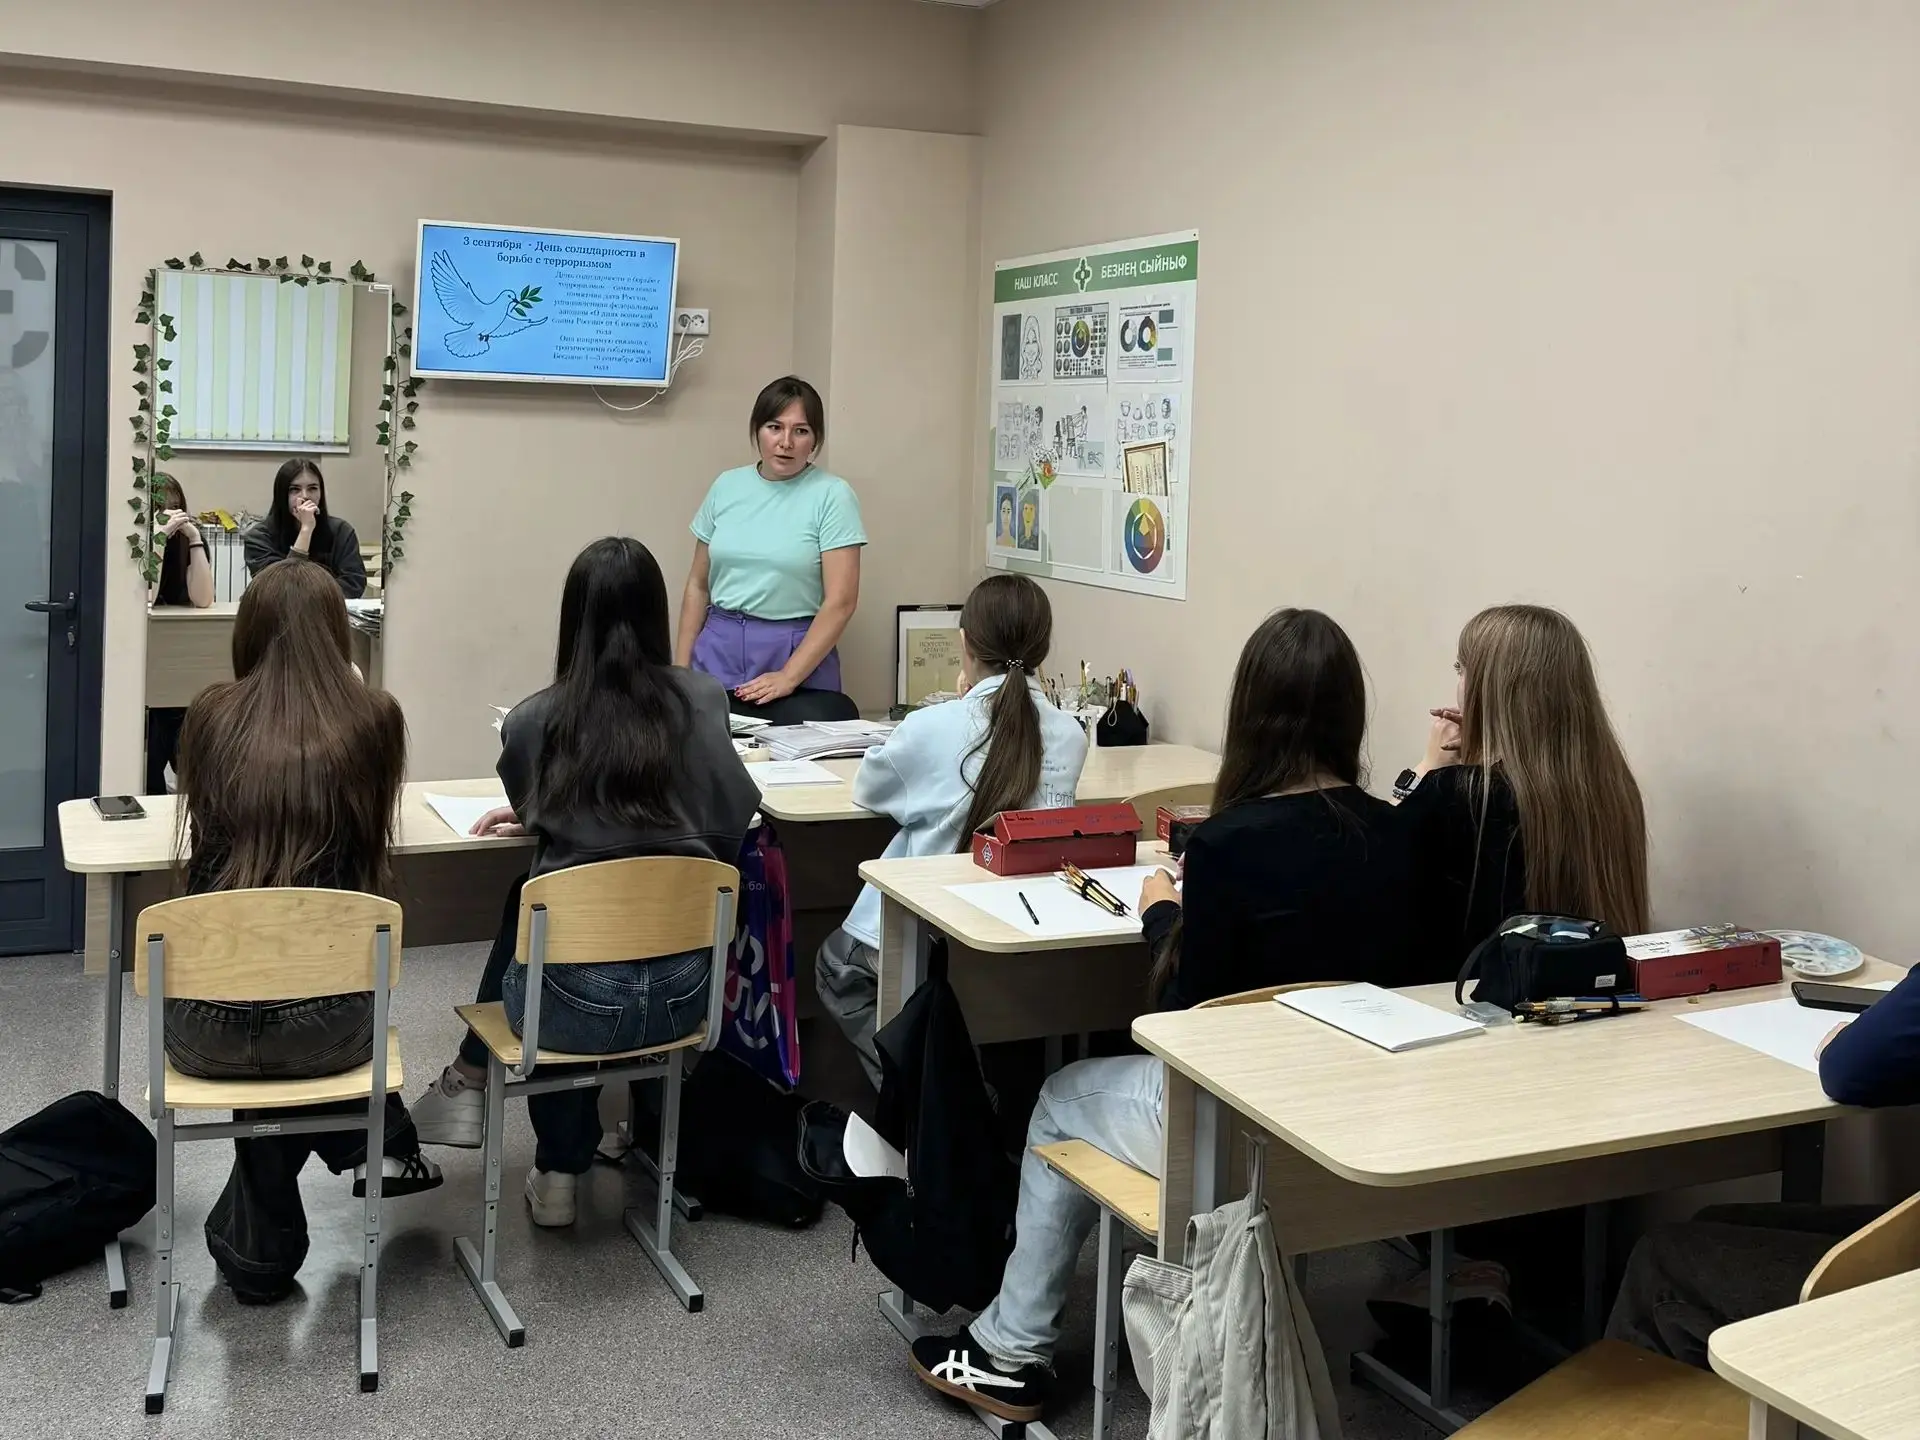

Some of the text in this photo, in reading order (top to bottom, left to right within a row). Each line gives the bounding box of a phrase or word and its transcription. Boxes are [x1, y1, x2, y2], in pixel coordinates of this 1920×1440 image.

[463, 236, 470, 246] 3
[472, 239, 522, 251] сентября
[534, 241, 563, 252] День
[565, 245, 637, 258] солидарности
[497, 252, 533, 264] борьбе
[543, 257, 612, 269] терроризмом
[1014, 277, 1032, 291] НАШ
[1033, 272, 1059, 288] КЛАСС
[1139, 254, 1188, 274] СЫЙНЫФ
